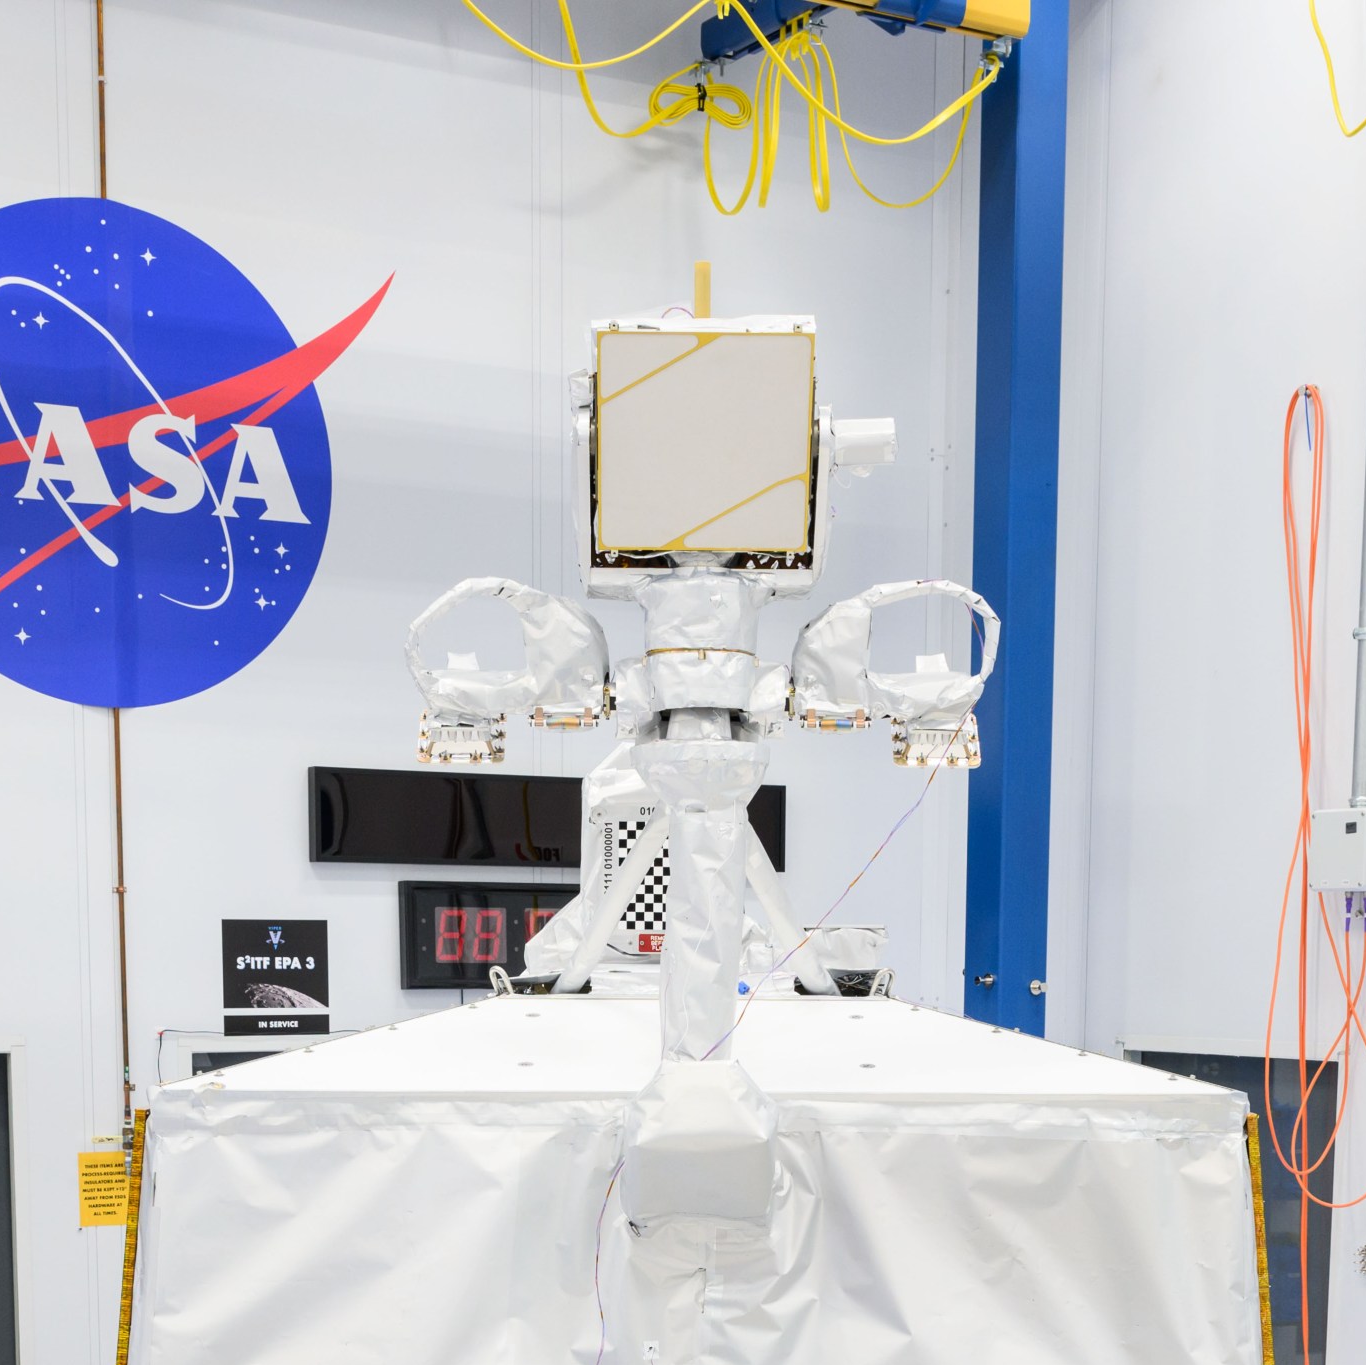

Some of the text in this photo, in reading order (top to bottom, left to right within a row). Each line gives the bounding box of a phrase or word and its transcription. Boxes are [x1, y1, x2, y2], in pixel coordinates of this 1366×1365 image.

[604, 822, 613, 869] 01000001
[275, 956, 302, 970] EPA
[305, 956, 315, 970] 3
[269, 1020, 299, 1028] SERVICE
